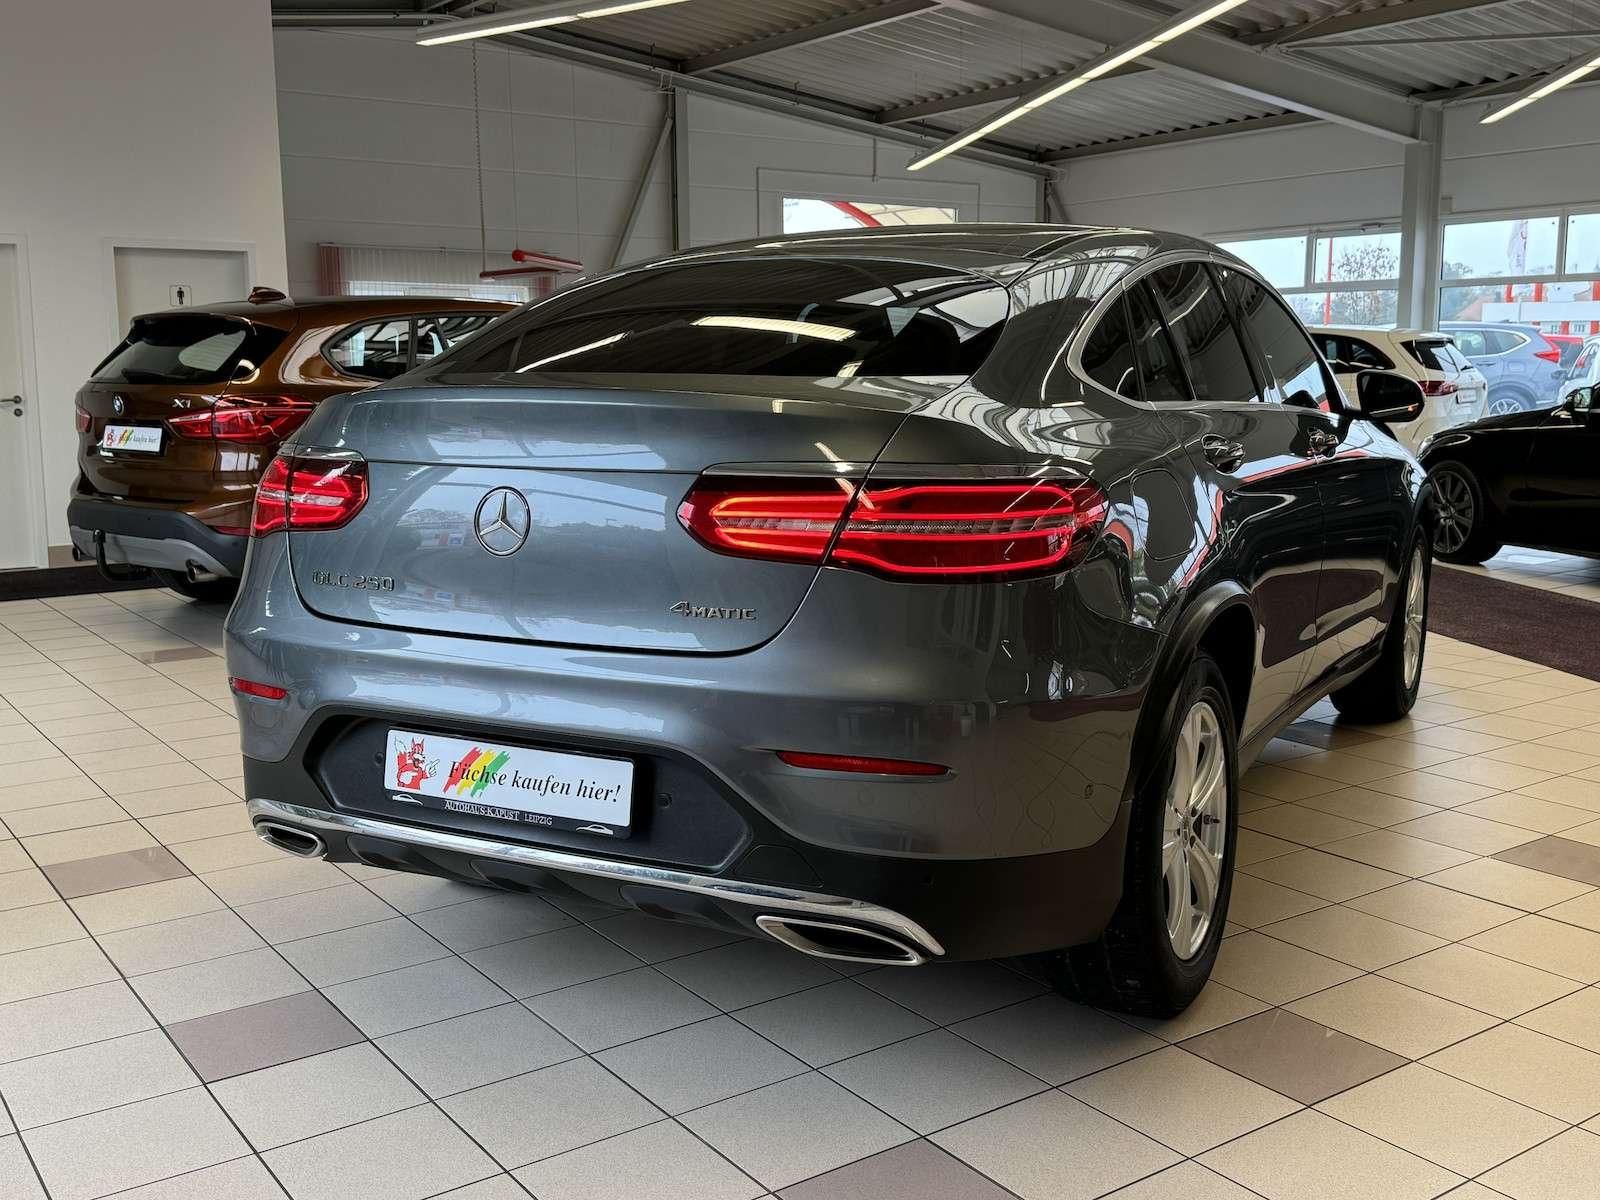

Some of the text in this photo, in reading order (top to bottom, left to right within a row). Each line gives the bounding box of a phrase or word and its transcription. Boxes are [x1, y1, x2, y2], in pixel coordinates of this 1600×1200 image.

[171, 398, 191, 409] X1
[351, 574, 395, 592] 250
[669, 600, 757, 620] 4MATIC
[449, 760, 621, 803] Füchse kaufen hier!
[524, 813, 553, 826] LEIPZIG
